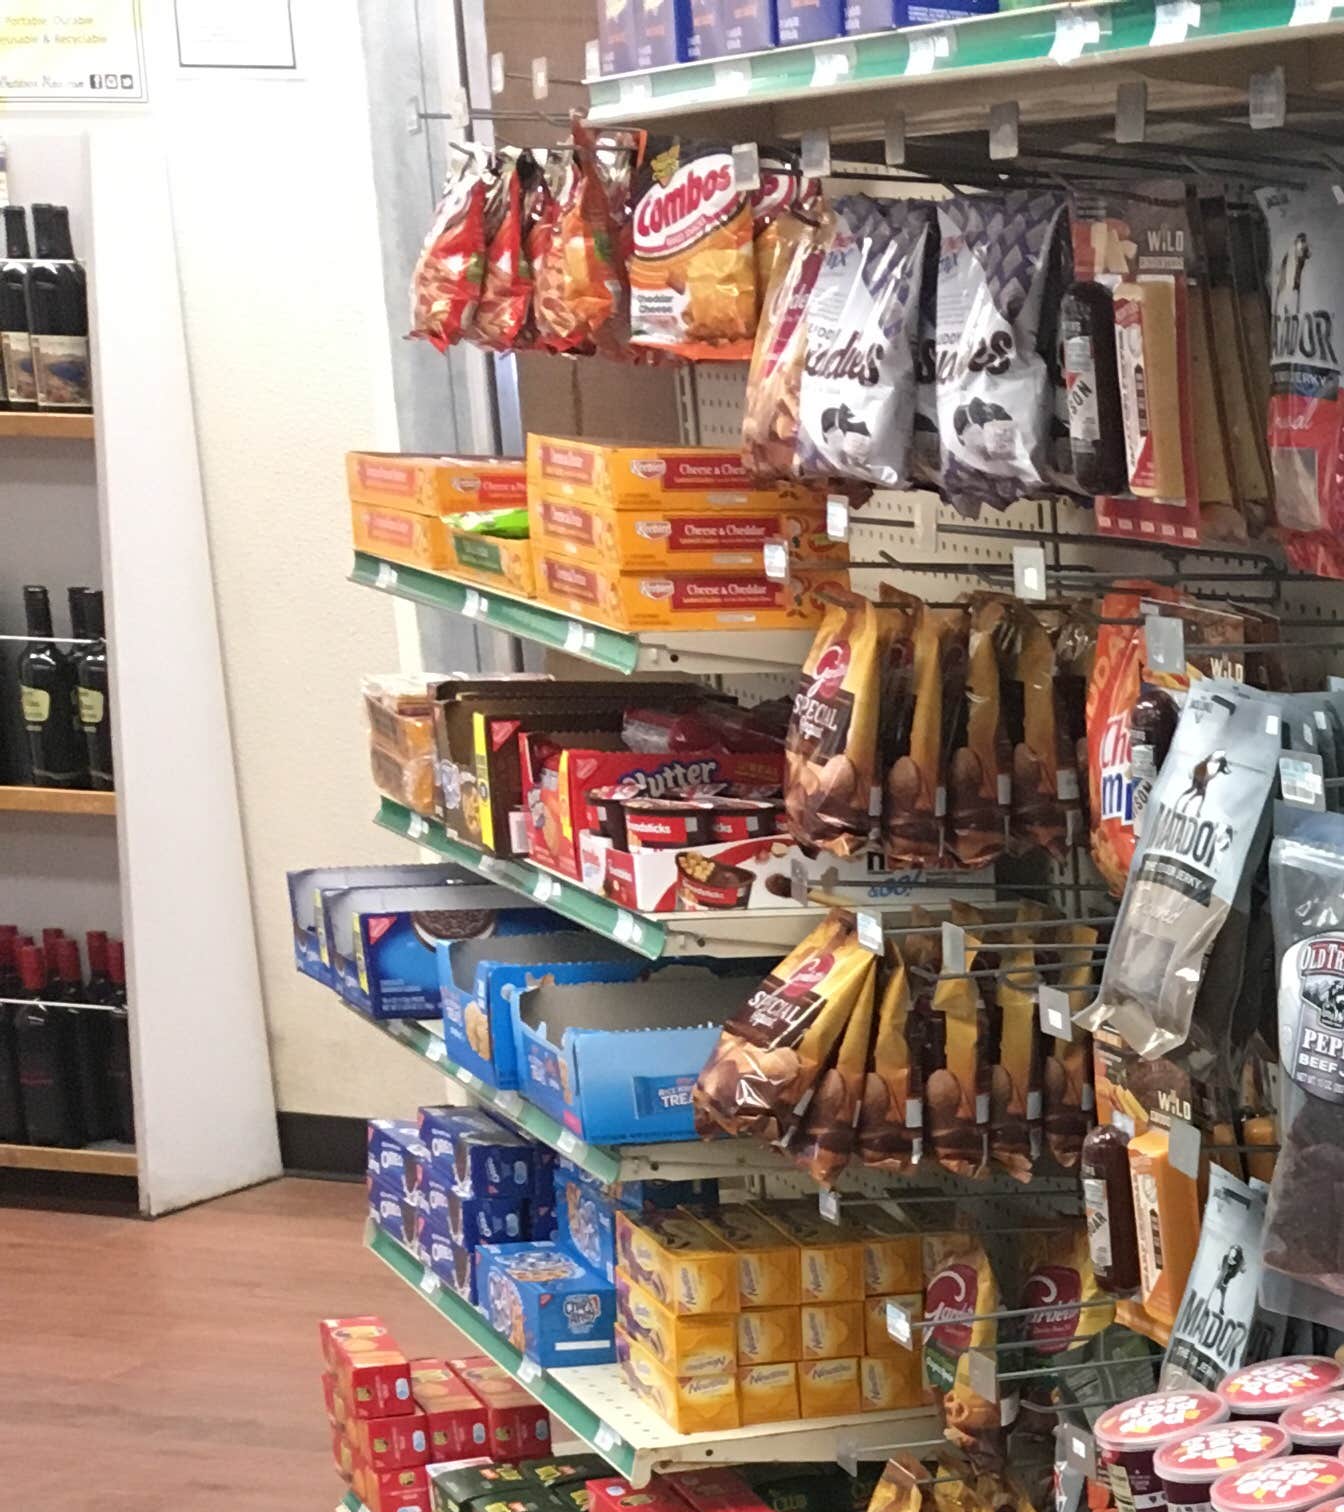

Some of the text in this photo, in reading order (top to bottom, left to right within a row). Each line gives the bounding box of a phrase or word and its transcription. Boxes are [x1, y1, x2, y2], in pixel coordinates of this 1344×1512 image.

[685, 523, 718, 537] Cheese
[687, 583, 720, 597] Cheese
[1300, 945, 1324, 972] OLD
[1299, 1053, 1338, 1073] BEEF
